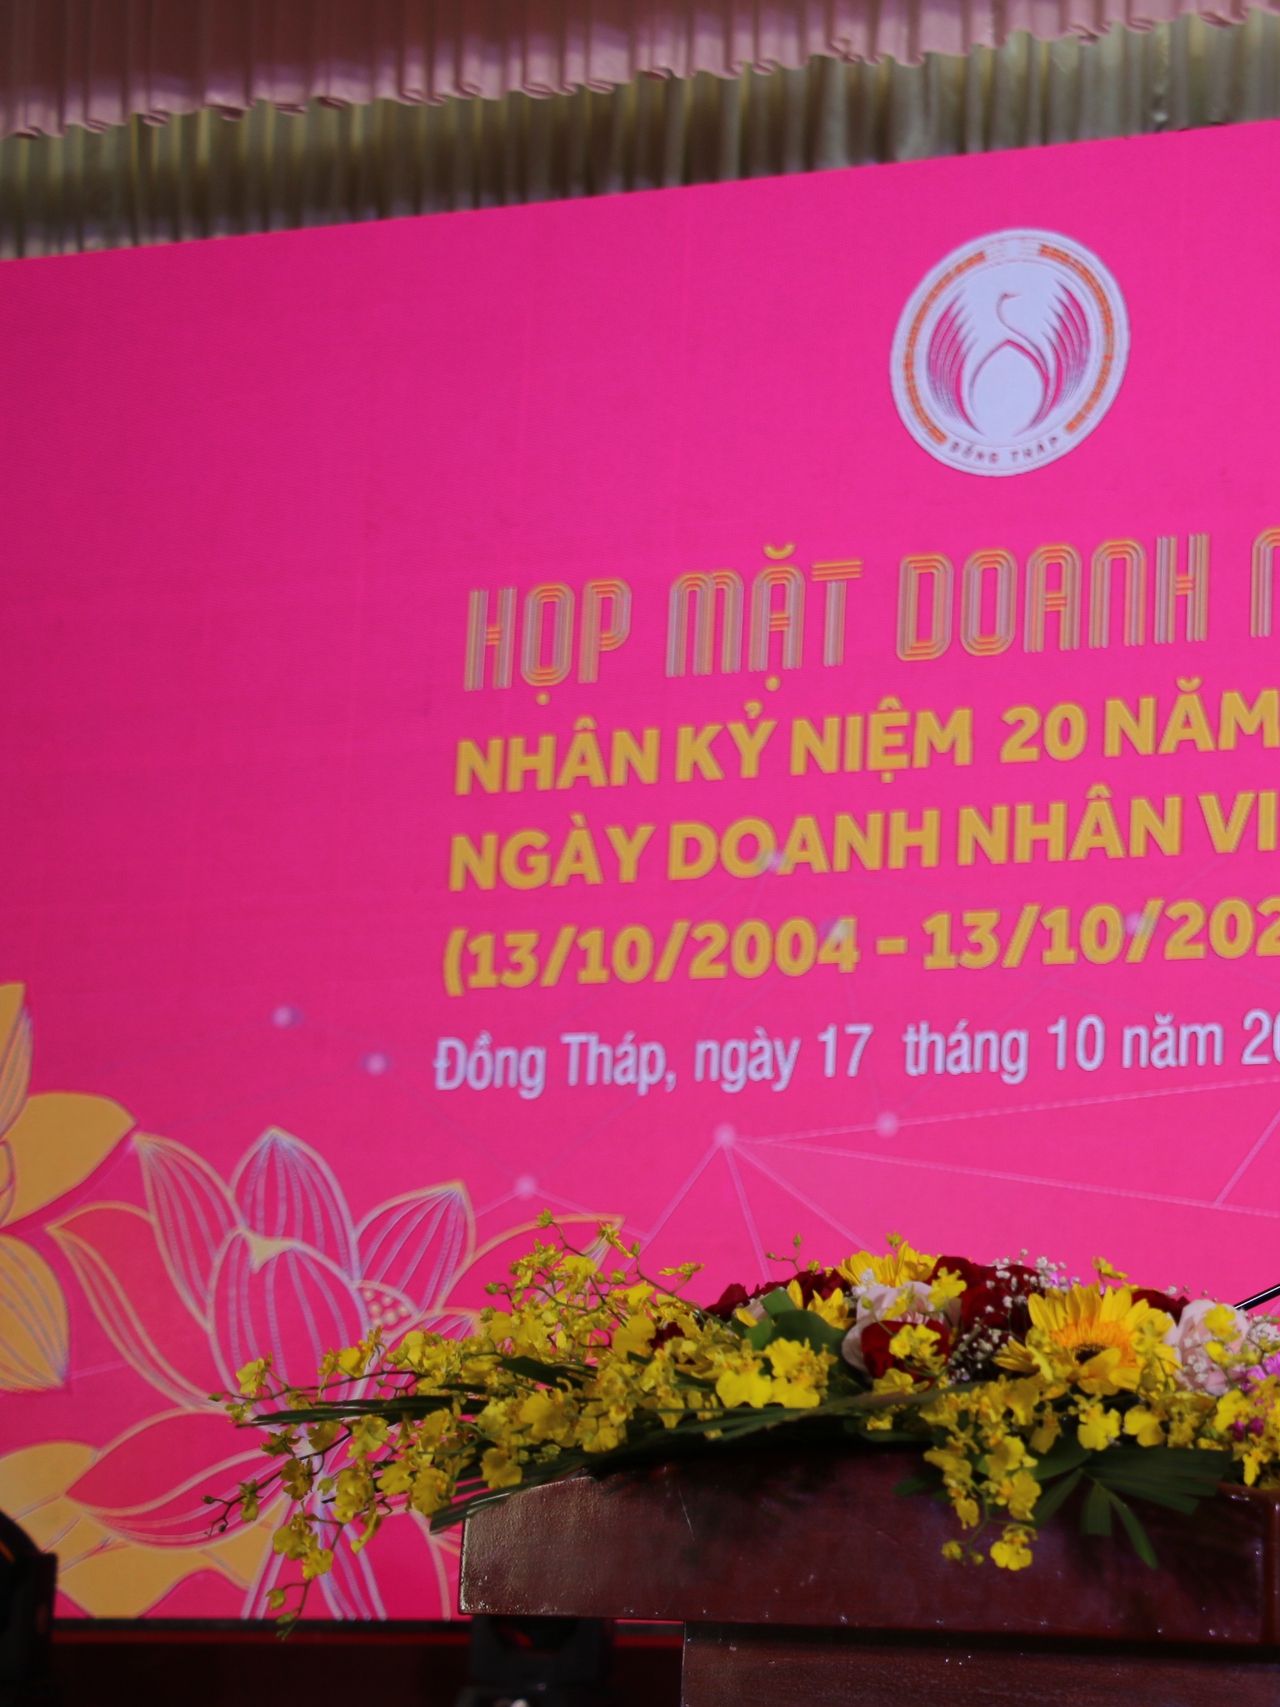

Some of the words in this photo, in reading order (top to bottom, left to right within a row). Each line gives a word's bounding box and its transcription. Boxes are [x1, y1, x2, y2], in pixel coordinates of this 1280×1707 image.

[464, 577, 632, 705] HỌP
[666, 542, 864, 692] MẶT
[896, 533, 1209, 661] DOANH
[455, 715, 661, 796] NHÂN
[675, 699, 778, 782] KỶ
[790, 695, 974, 784] NIỆM
[1000, 703, 1088, 763] 20
[449, 814, 656, 892] NGÀY
[667, 807, 941, 881] DOANH
[957, 784, 1183, 866] NHÂN
[442, 915, 861, 997] (13/10/2004
[875, 936, 909, 956] -
[433, 1030, 548, 1100] Đồng
[560, 1030, 677, 1097] Tháp,
[693, 1026, 801, 1093] ngày
[817, 1022, 874, 1079] 17
[902, 1019, 1029, 1085] tháng
[1047, 1014, 1104, 1071] 10
[1122, 1012, 1224, 1069] năm
